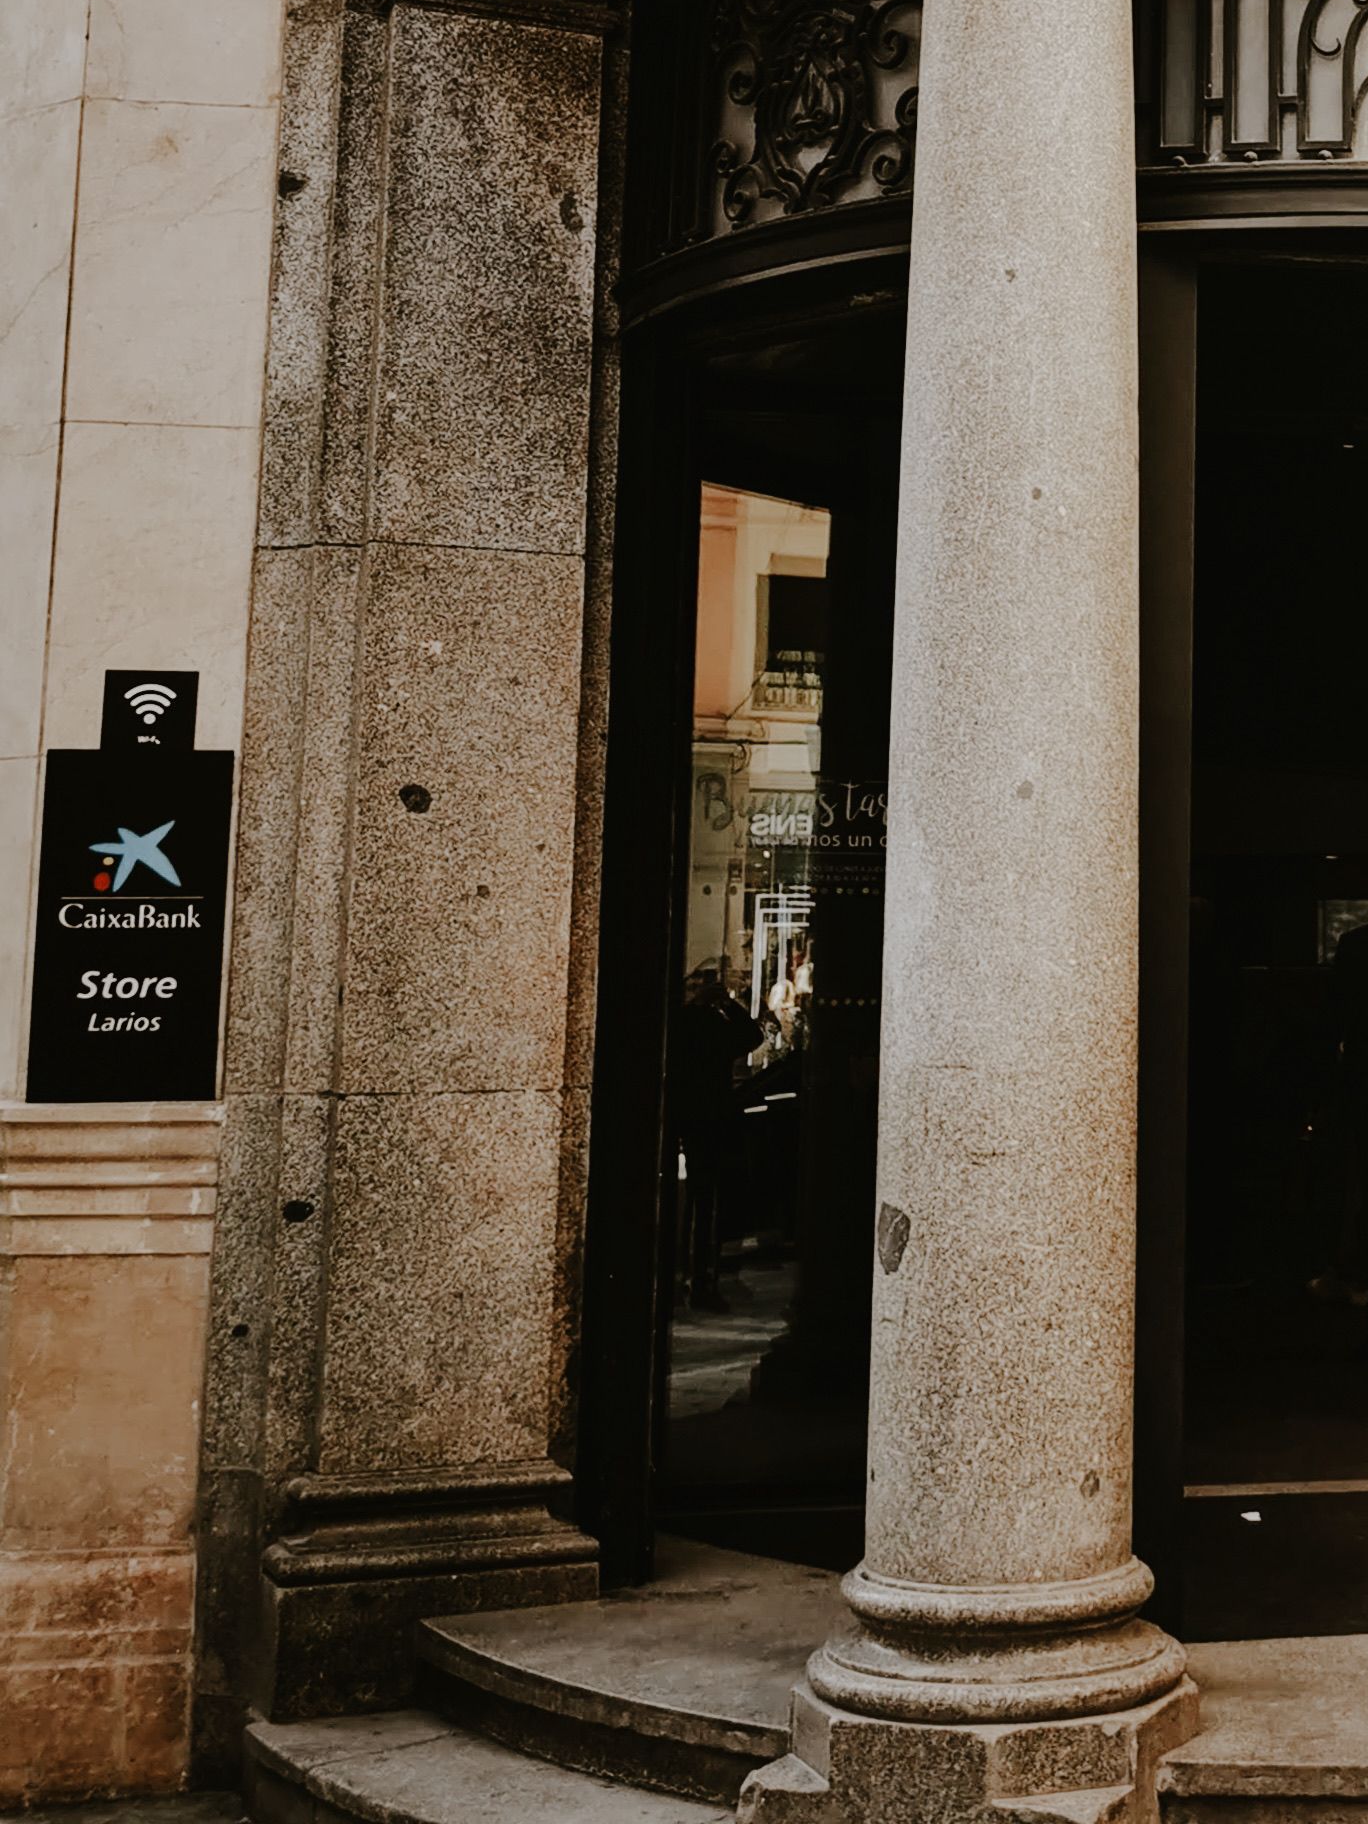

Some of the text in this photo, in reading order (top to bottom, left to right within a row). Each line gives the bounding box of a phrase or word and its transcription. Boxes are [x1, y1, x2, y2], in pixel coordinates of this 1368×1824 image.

[847, 834, 873, 848] un
[58, 903, 201, 930] CaixaBank
[76, 969, 178, 1000] Store
[87, 1011, 162, 1033] Larios
